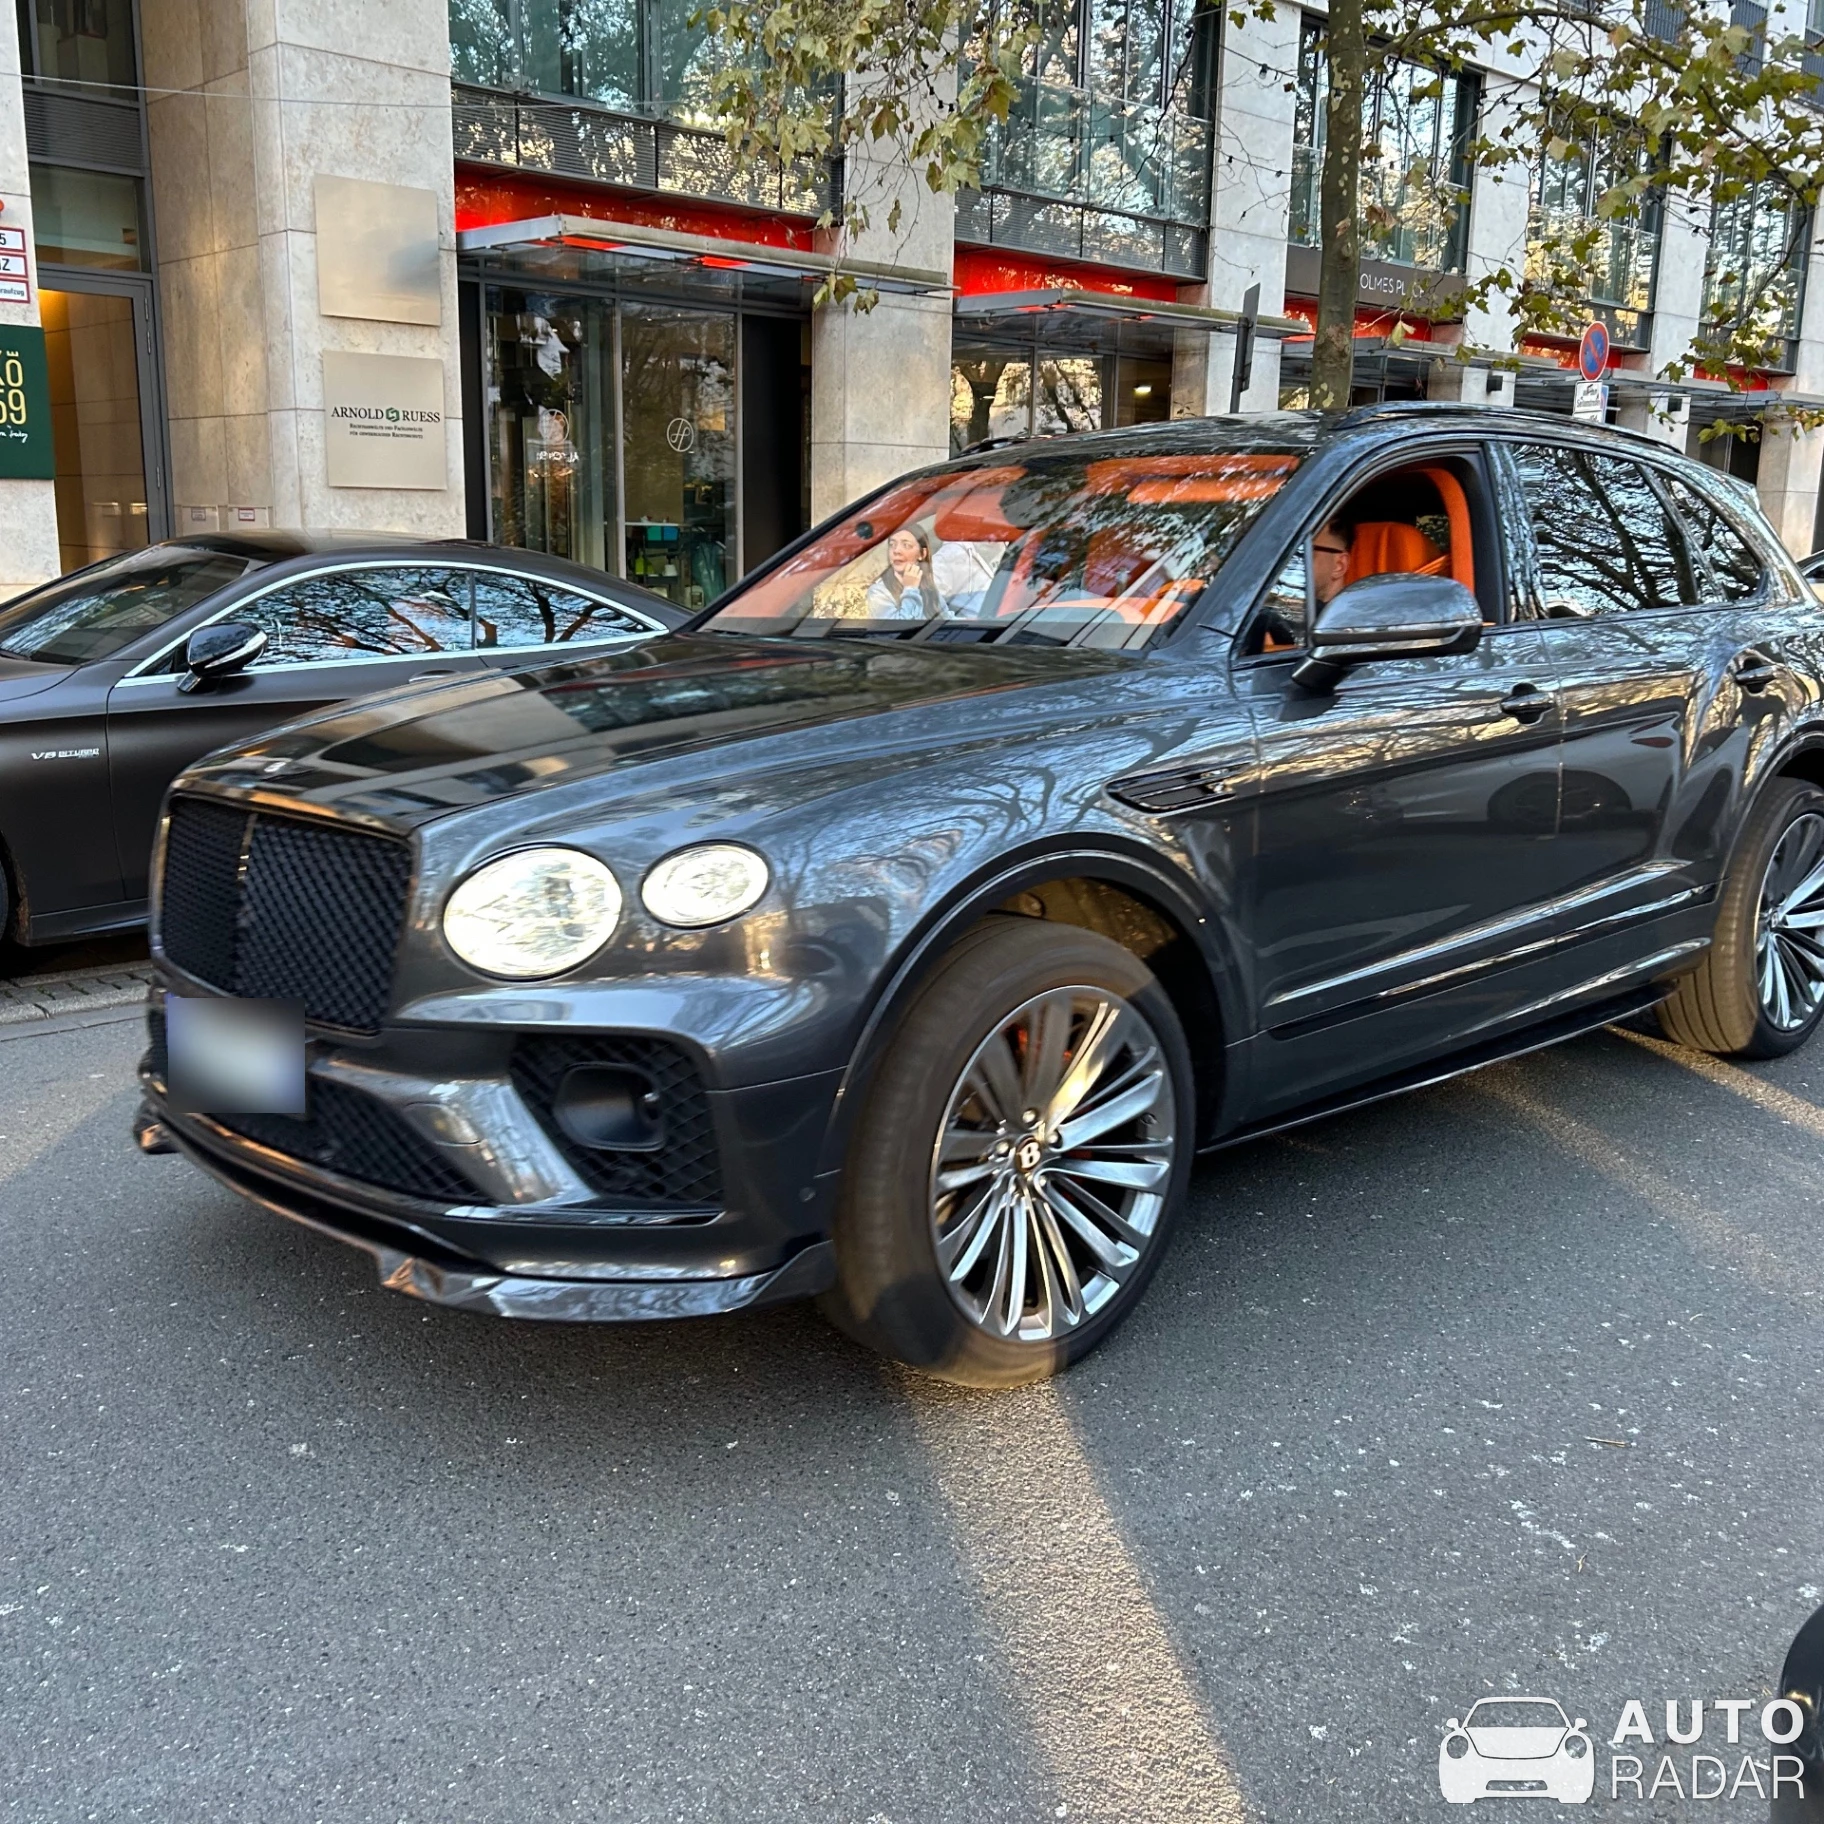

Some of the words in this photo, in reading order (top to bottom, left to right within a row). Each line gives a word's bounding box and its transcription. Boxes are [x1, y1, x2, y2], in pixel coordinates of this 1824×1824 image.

[331, 406, 384, 420] ARNOLD
[402, 410, 441, 423] RUESS
[31, 750, 57, 760] V8
